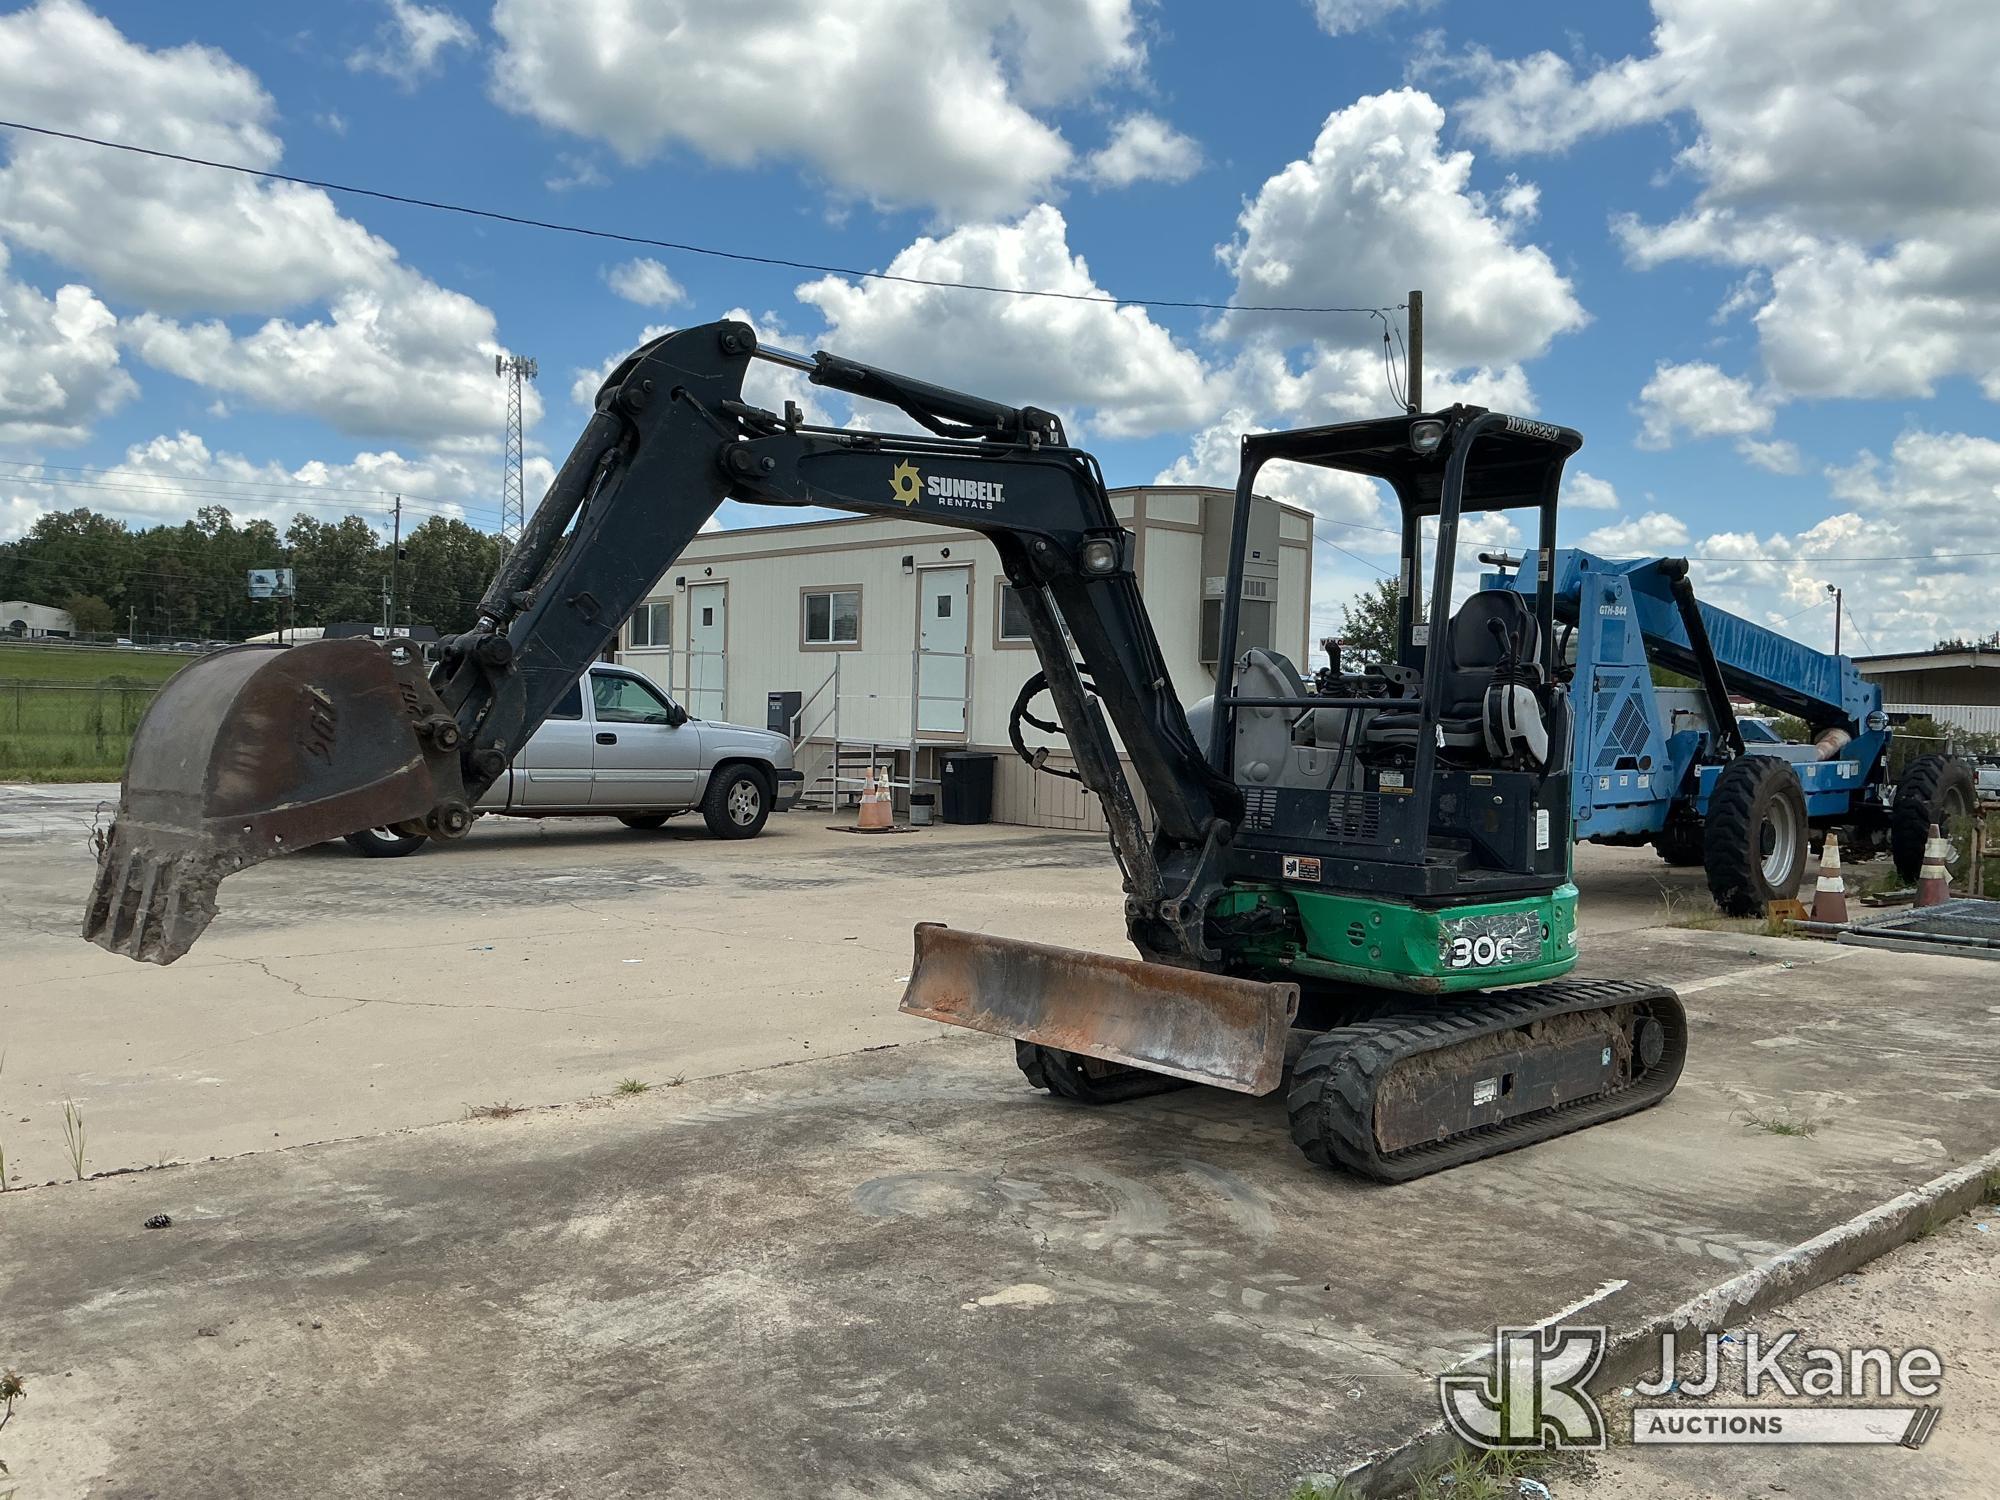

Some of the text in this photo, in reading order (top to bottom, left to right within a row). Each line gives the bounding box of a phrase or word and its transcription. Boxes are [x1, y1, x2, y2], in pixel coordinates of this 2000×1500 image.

[927, 475, 1004, 502] SUNBELT
[938, 498, 993, 510] RENTALS
[1600, 604, 1627, 616] GTH-844
[1451, 936, 1513, 967] 30G
